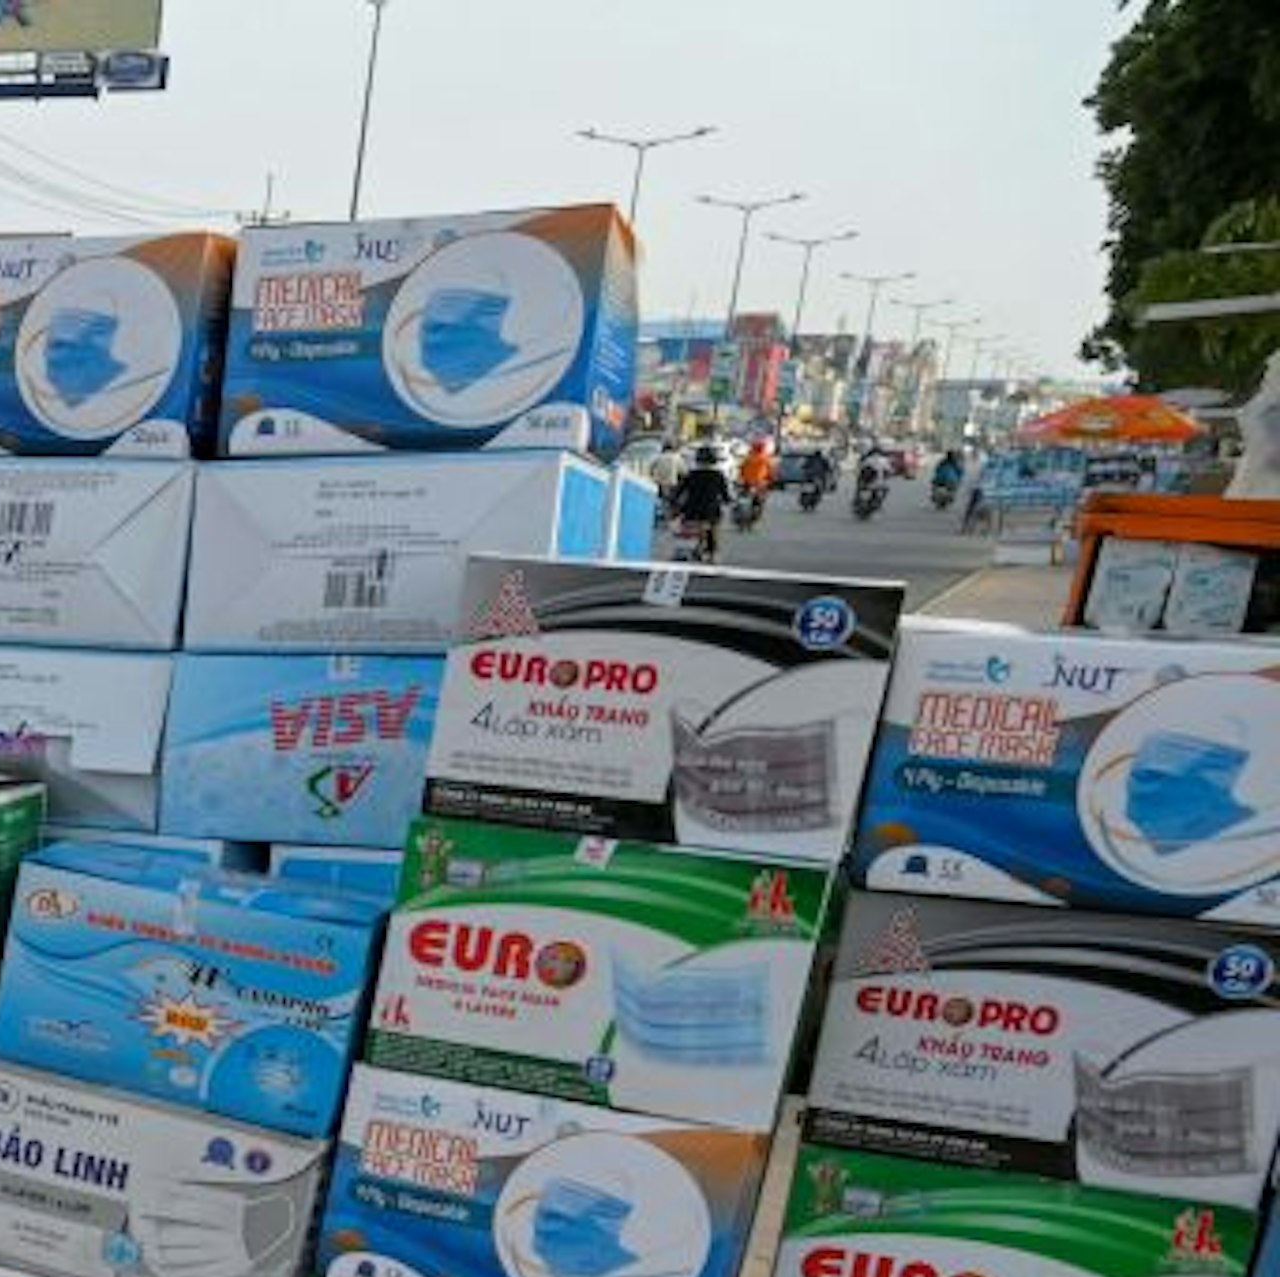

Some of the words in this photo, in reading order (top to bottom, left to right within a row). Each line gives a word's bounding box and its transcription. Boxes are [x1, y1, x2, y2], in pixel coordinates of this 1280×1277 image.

[808, 605, 839, 631] 50
[470, 651, 658, 695] EUROPRO
[1053, 664, 1125, 696] NUT
[270, 684, 423, 752] ASIA
[585, 705, 649, 727] TRANG
[919, 691, 1061, 734] MEDICAL
[408, 919, 588, 990] EURO
[1225, 953, 1257, 978] 50
[857, 985, 1060, 1035] EUROPRO
[980, 1042, 1050, 1067] TRANG
[472, 1102, 530, 1139] NUT
[54, 1147, 130, 1191] LINH
